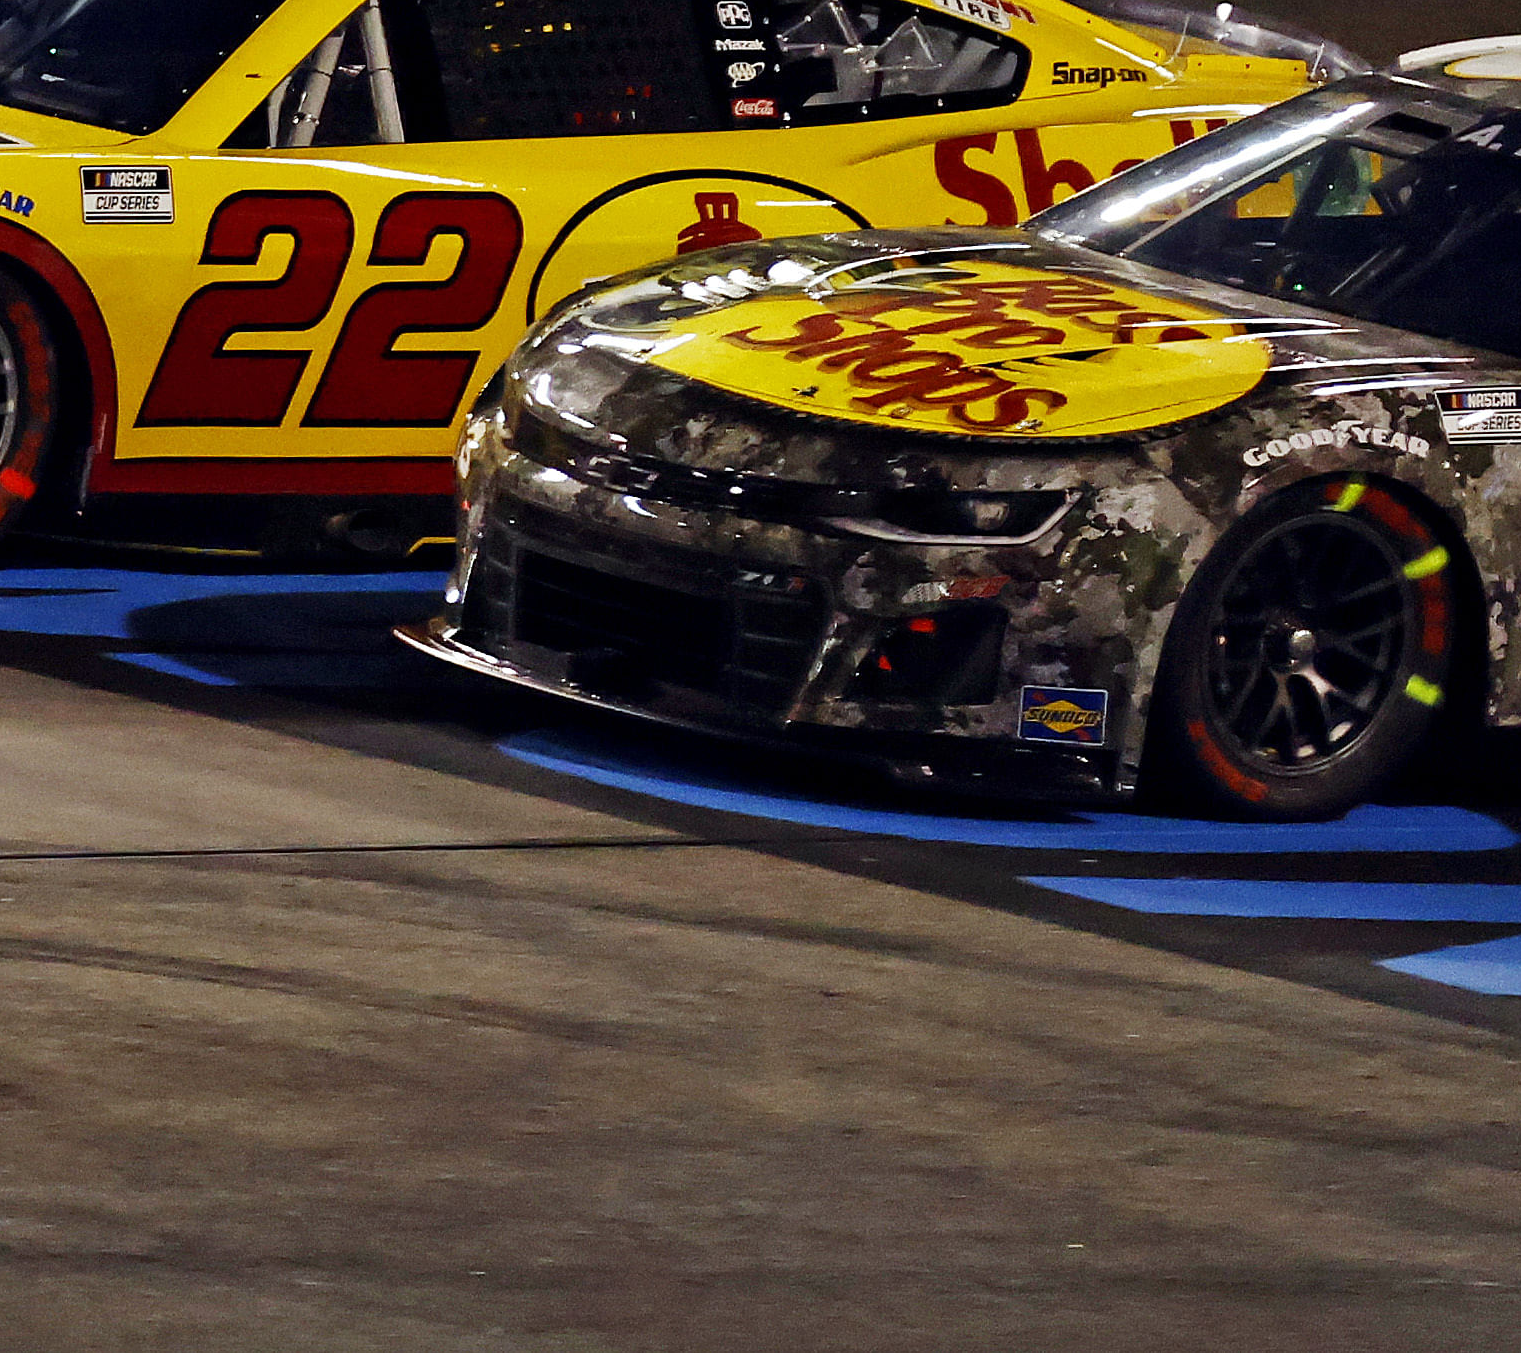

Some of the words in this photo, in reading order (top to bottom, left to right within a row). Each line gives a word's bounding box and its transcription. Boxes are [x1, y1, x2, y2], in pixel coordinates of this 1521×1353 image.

[715, 39, 766, 51] Mazak
[1051, 61, 1147, 88] Snap-on
[1460, 123, 1504, 153] A.
[110, 172, 158, 188] NASCAR
[96, 196, 119, 210] CUP
[120, 195, 160, 210] SERIES
[133, 187, 525, 428] 22
[718, 311, 1068, 431] Shops
[1467, 391, 1517, 408] NASCAR
[1243, 419, 1431, 467] GOODYEAR
[1024, 706, 1099, 726] SUNOCO
